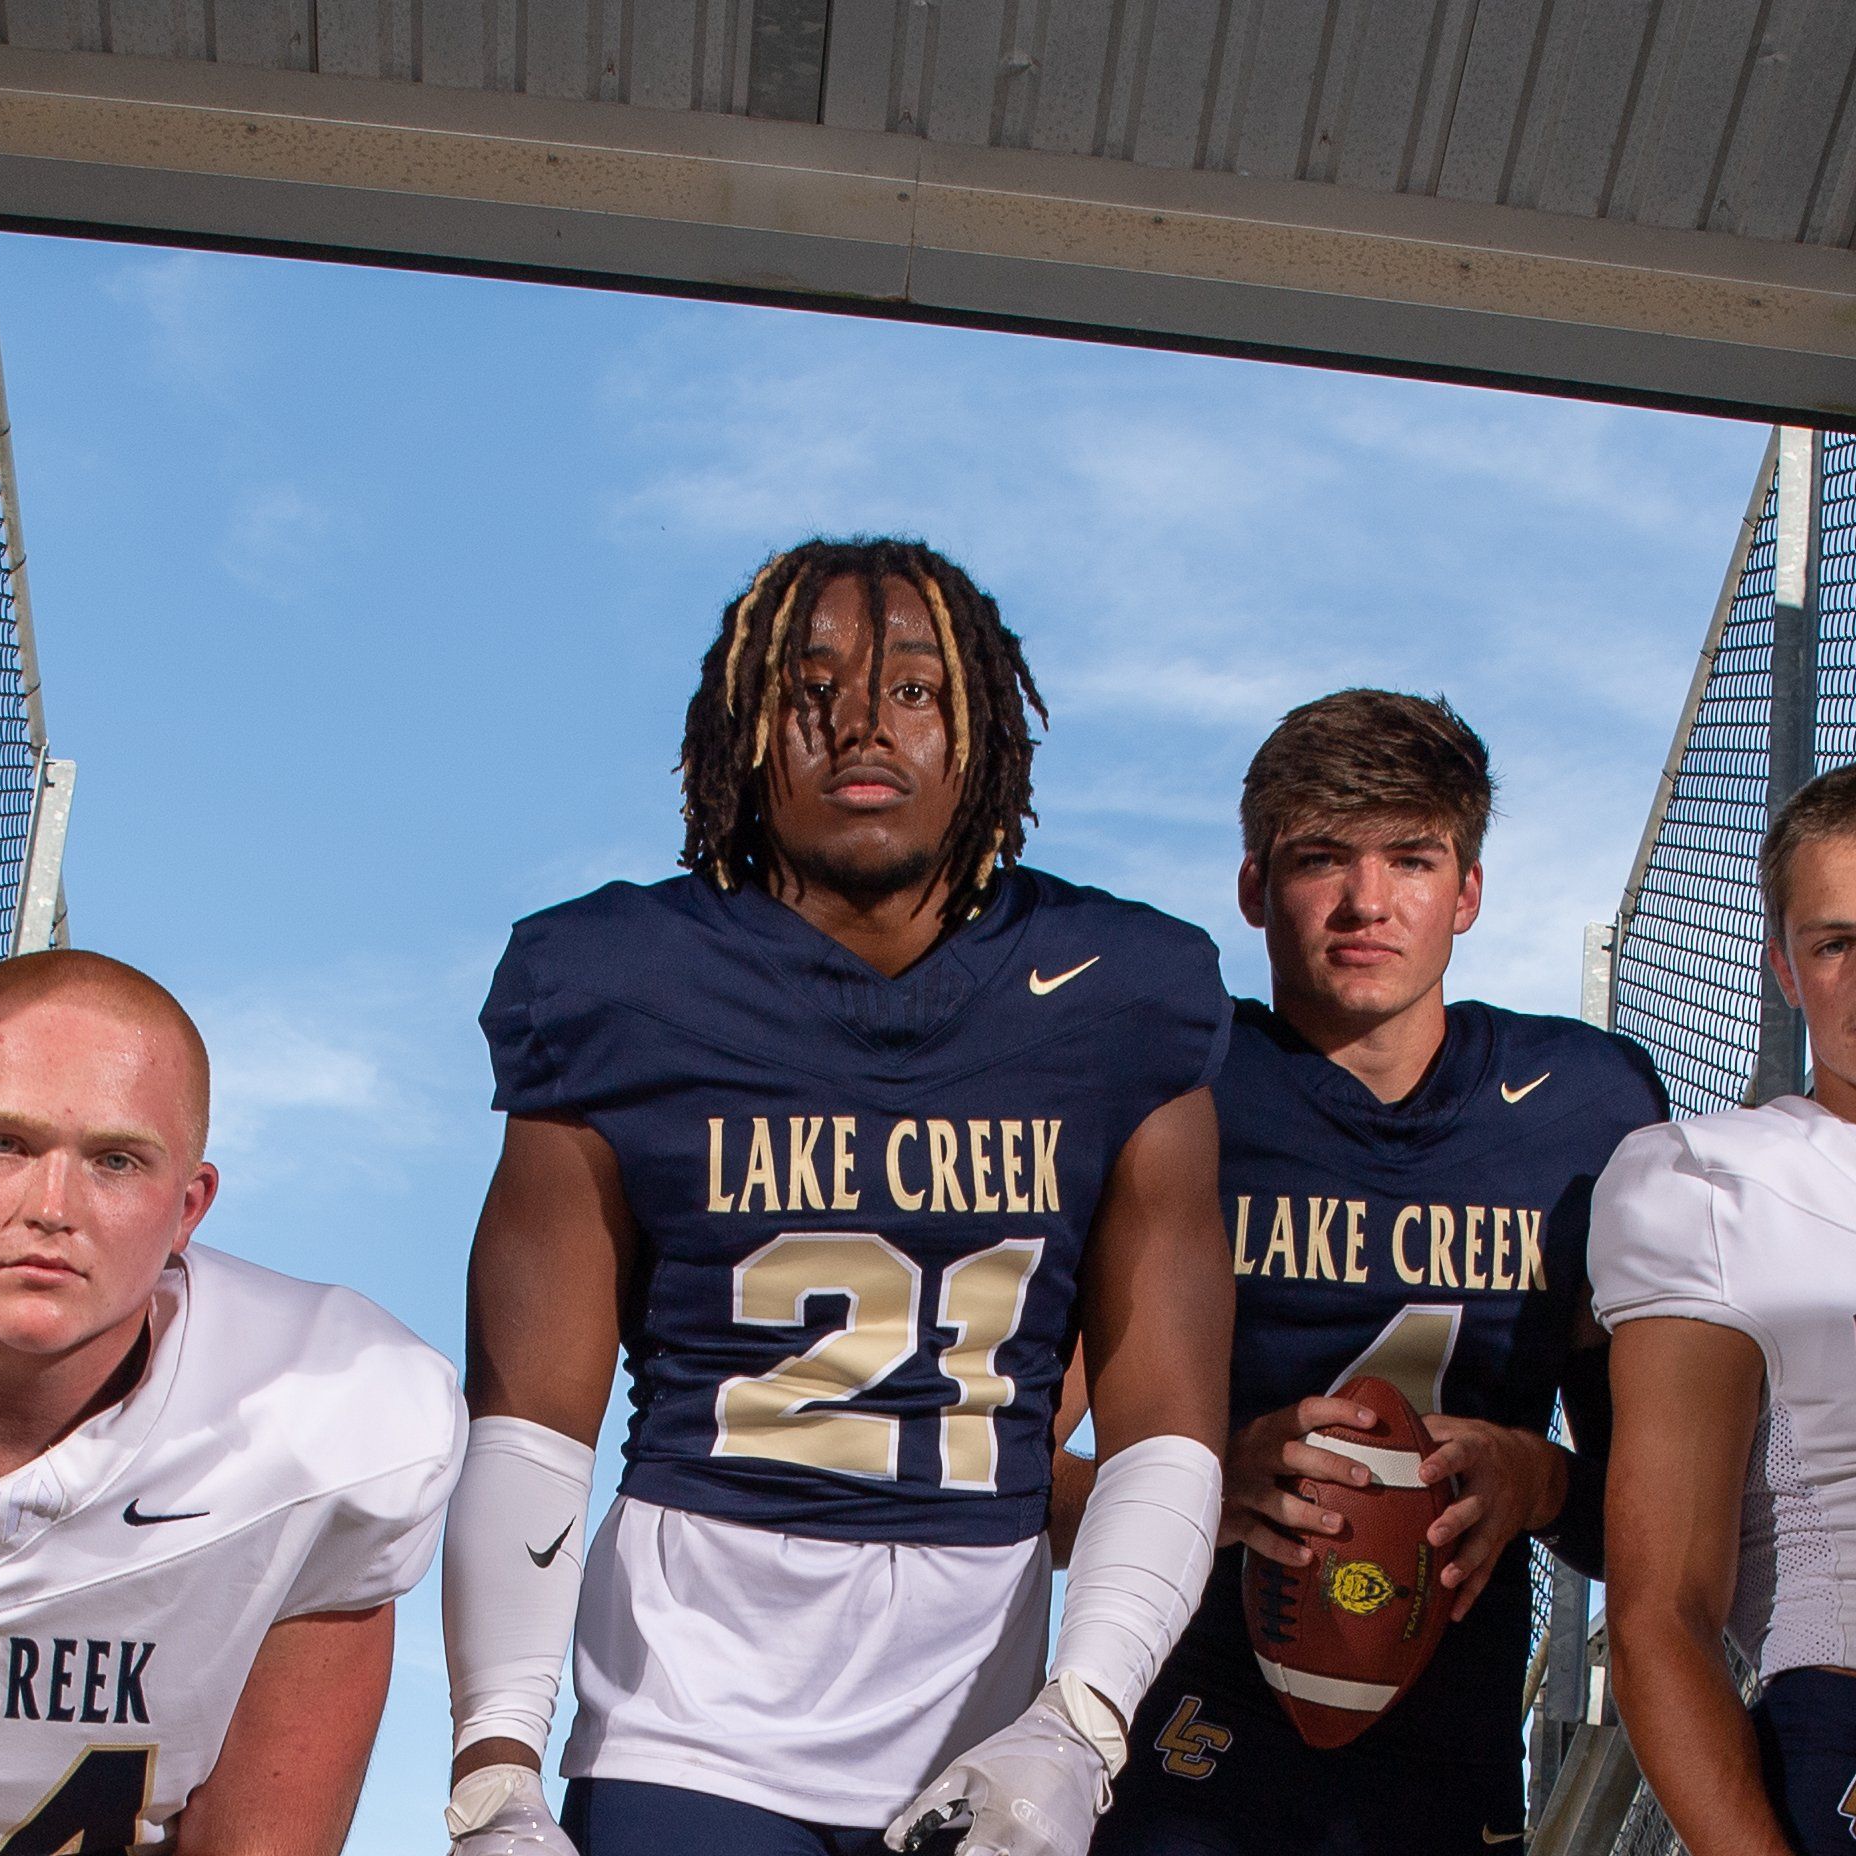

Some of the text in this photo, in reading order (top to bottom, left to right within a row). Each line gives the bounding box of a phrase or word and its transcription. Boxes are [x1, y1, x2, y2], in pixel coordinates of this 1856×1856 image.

[707, 1117, 1062, 1214] LAKE CREEK
[1234, 1196, 1547, 1291] LAKE CREEK
[710, 1232, 1045, 1492] 21
[1154, 1695, 1233, 1780] LC
